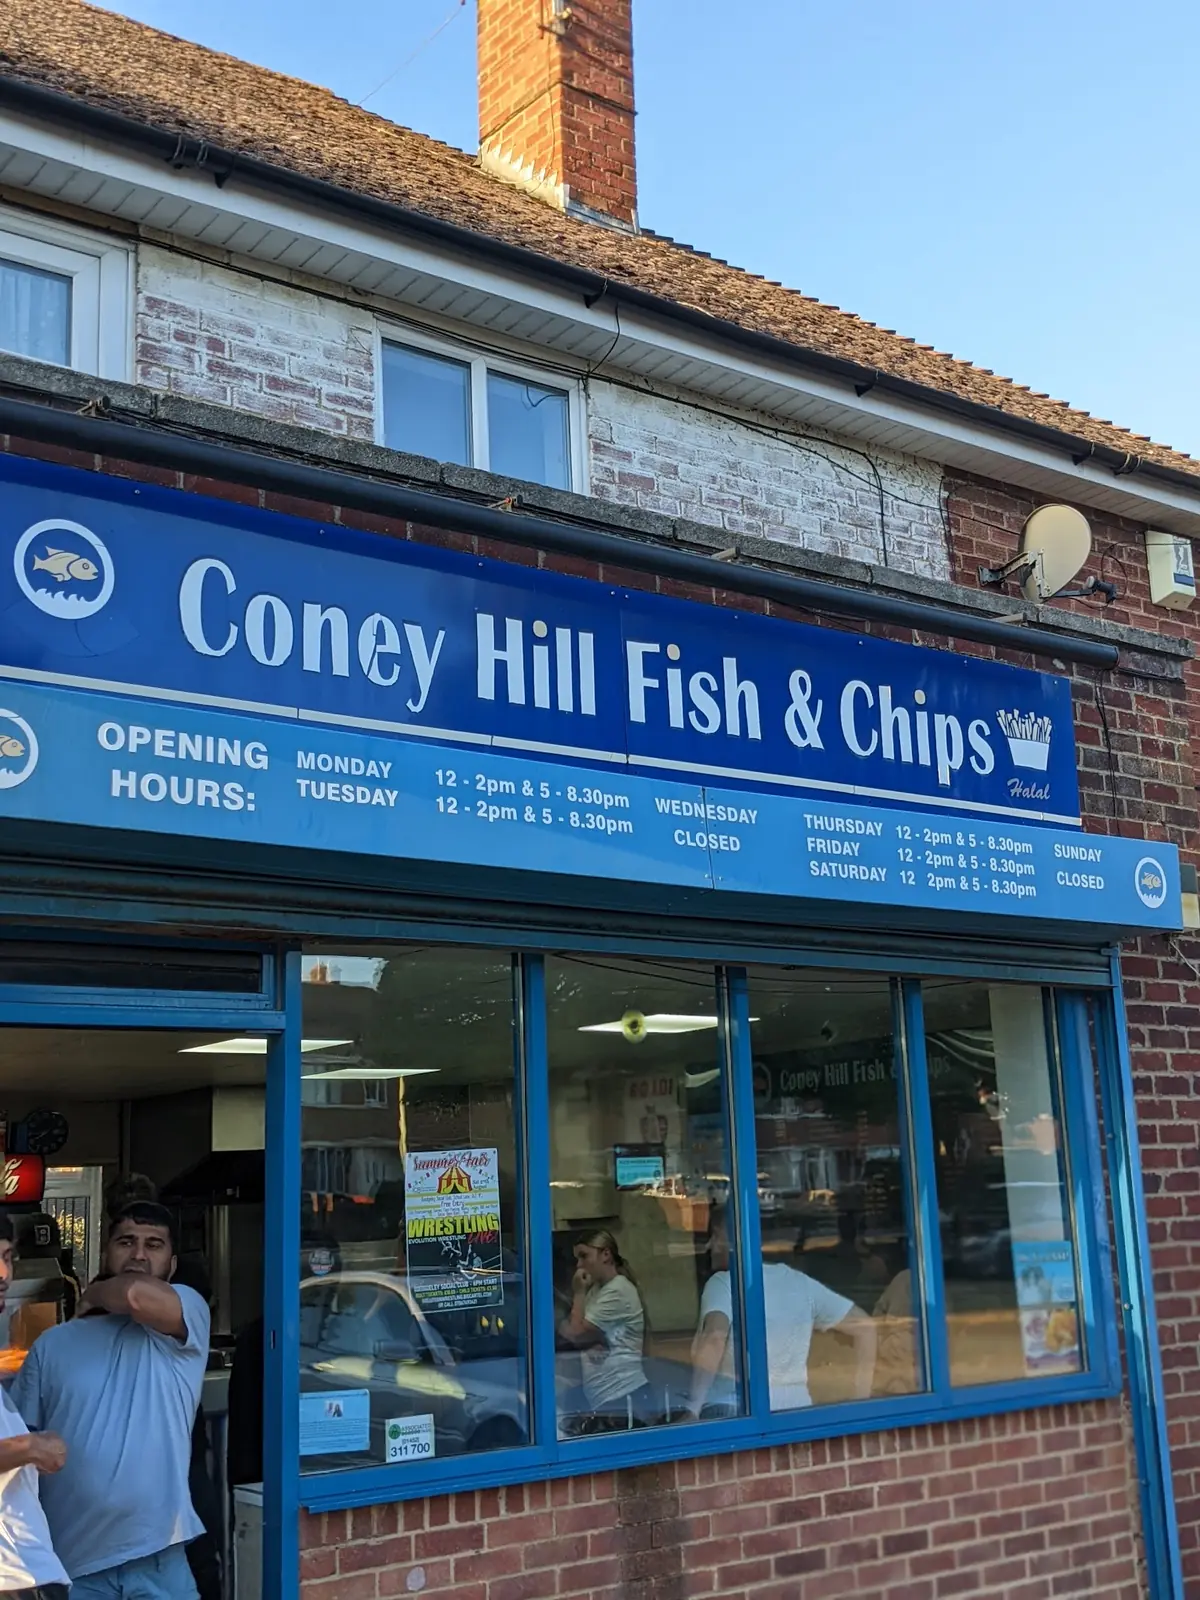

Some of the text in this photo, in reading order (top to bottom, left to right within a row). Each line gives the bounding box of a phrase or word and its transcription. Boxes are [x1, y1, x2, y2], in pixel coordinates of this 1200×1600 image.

[178, 558, 995, 786] Coney Hill Fish & Chips
[97, 721, 269, 770] OPENING
[110, 769, 256, 812] HOURS:
[296, 750, 392, 779] MONDAY
[435, 768, 457, 787] 12
[475, 773, 516, 796] 2pm
[522, 779, 534, 797] &
[539, 782, 550, 799] 5
[566, 785, 630, 810] 8.30pm
[1006, 777, 1051, 800] Halal
[296, 779, 399, 807] TUESDAY
[435, 796, 458, 815] 12
[476, 800, 518, 823] 2pm
[523, 805, 536, 823] &
[541, 808, 553, 825] 5
[569, 811, 634, 836] 8.30pm
[655, 797, 758, 825] WEDNESDAY
[673, 829, 741, 852] CLOSED
[803, 813, 884, 837] THURSDAY
[895, 824, 912, 840] 12
[923, 827, 952, 847] 2pm
[956, 831, 965, 847] &
[968, 833, 977, 848] 5
[988, 835, 1033, 856] 8.30pm
[806, 837, 860, 857] FRIDAY
[896, 847, 913, 863] 12
[925, 850, 954, 869] 2pm
[957, 853, 967, 869] &
[970, 855, 979, 870] 5
[989, 857, 1035, 877] 8.30pm
[1053, 843, 1102, 863] SUNDAY
[809, 860, 887, 882] SATURDAY
[899, 870, 916, 886] 12
[926, 872, 956, 891] 2pm
[959, 875, 969, 891] &
[972, 876, 980, 892] 5
[991, 878, 1037, 899] 8.30pm
[1056, 870, 1105, 890] CLOSED
[824, 1061, 849, 1087] Hill
[852, 1058, 885, 1083] Fish
[408, 1213, 499, 1239] WRESTLING
[408, 1236, 437, 1245] EVOLUTION
[438, 1234, 467, 1242] WRESTLING
[390, 1442, 431, 1457] 311 700
